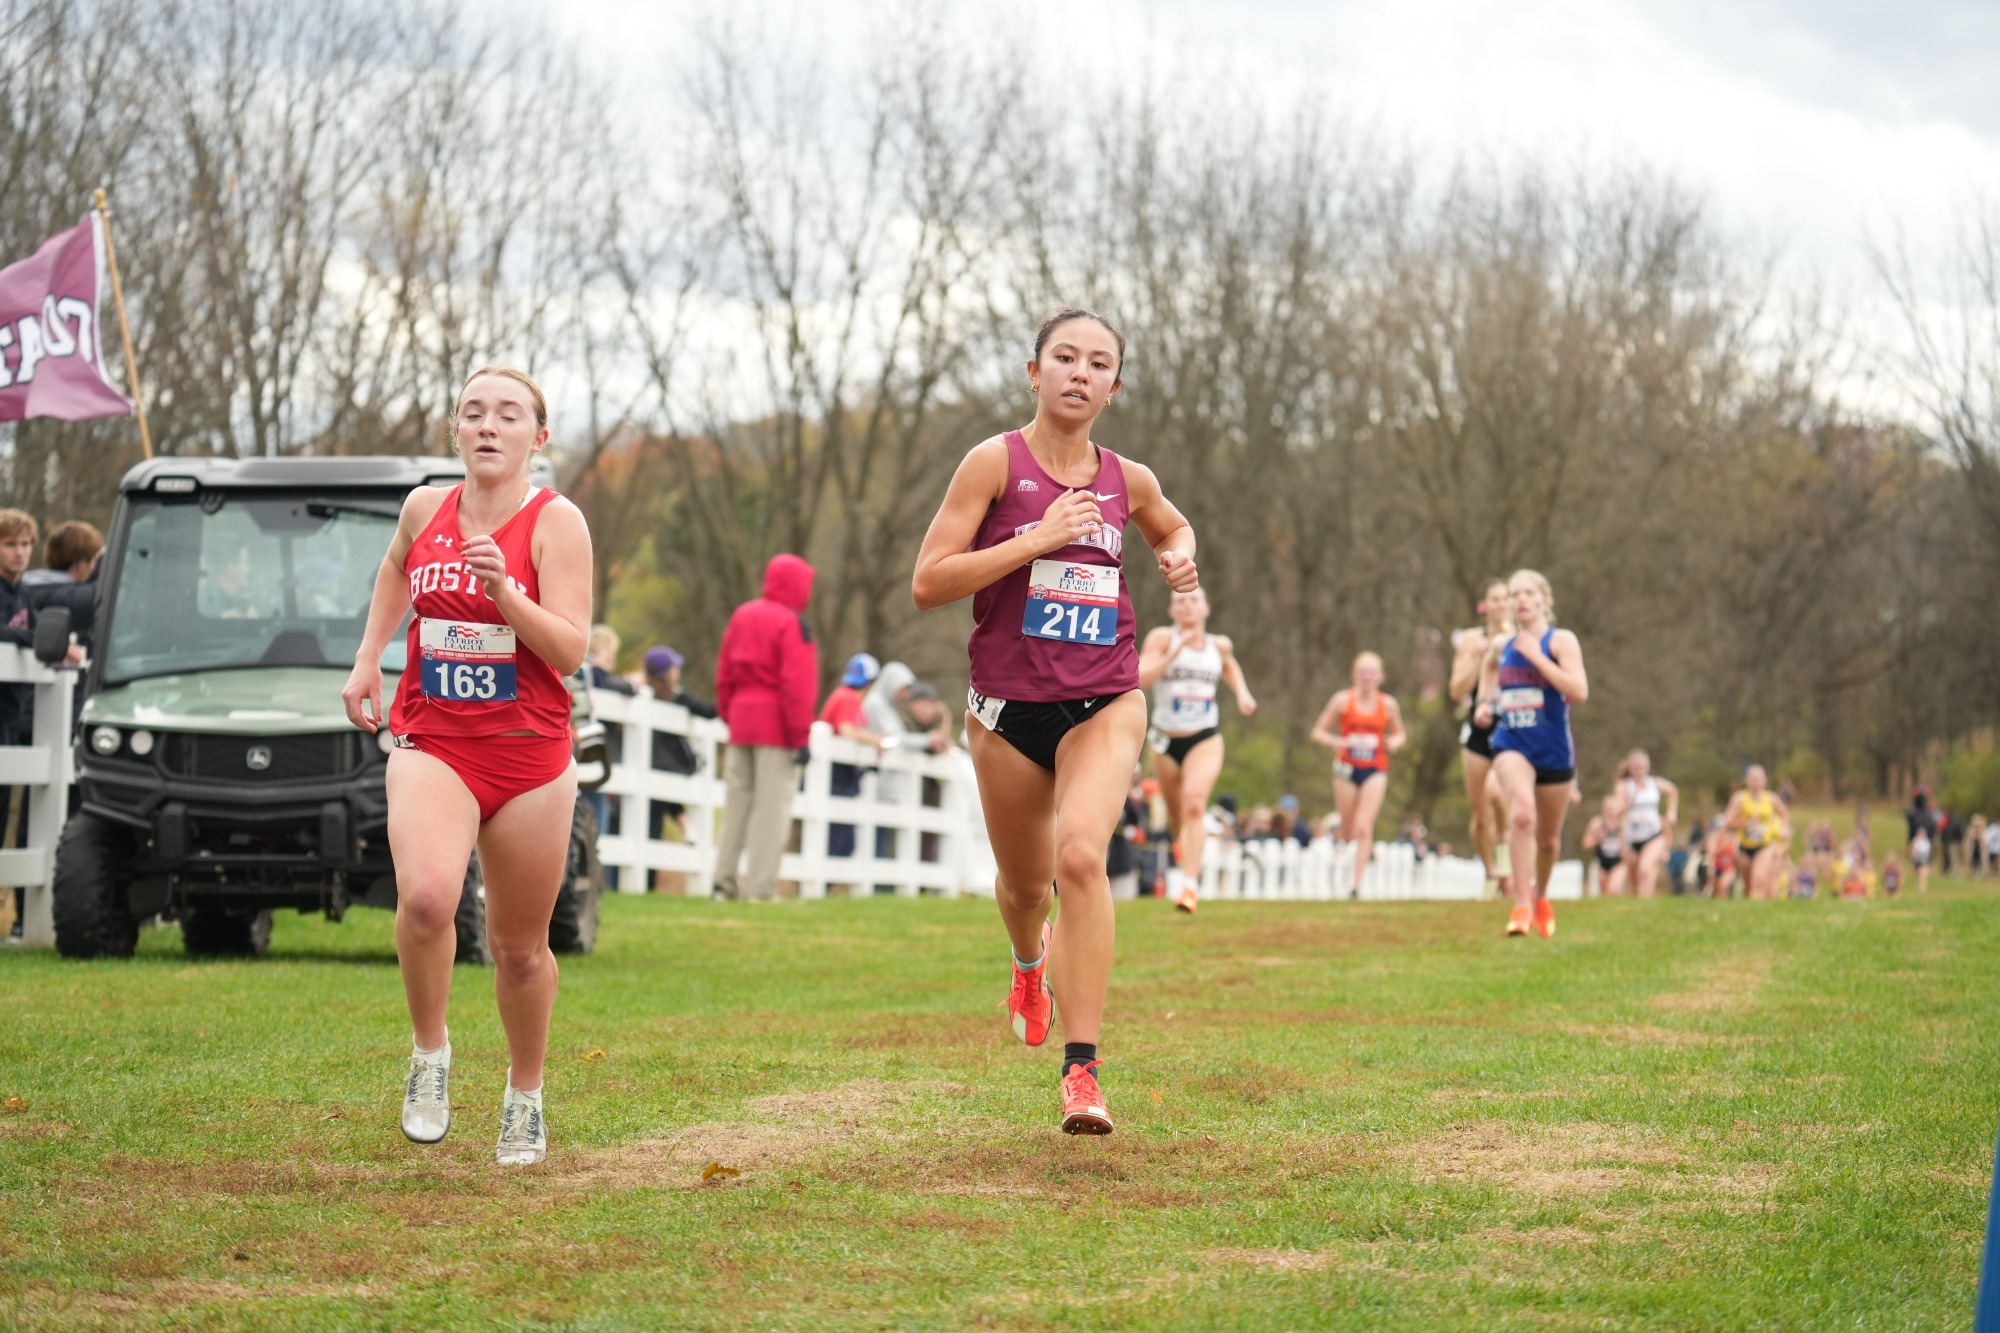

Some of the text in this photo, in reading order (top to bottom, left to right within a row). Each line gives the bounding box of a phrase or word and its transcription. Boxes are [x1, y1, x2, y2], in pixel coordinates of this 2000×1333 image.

[1059, 577, 1097, 588] PATRIOT
[1059, 583, 1097, 593] LEAGUE
[1040, 602, 1101, 641] 214
[444, 636, 485, 645] PATRIOT
[444, 642, 485, 652] LEAGUE
[435, 662, 497, 699] 163
